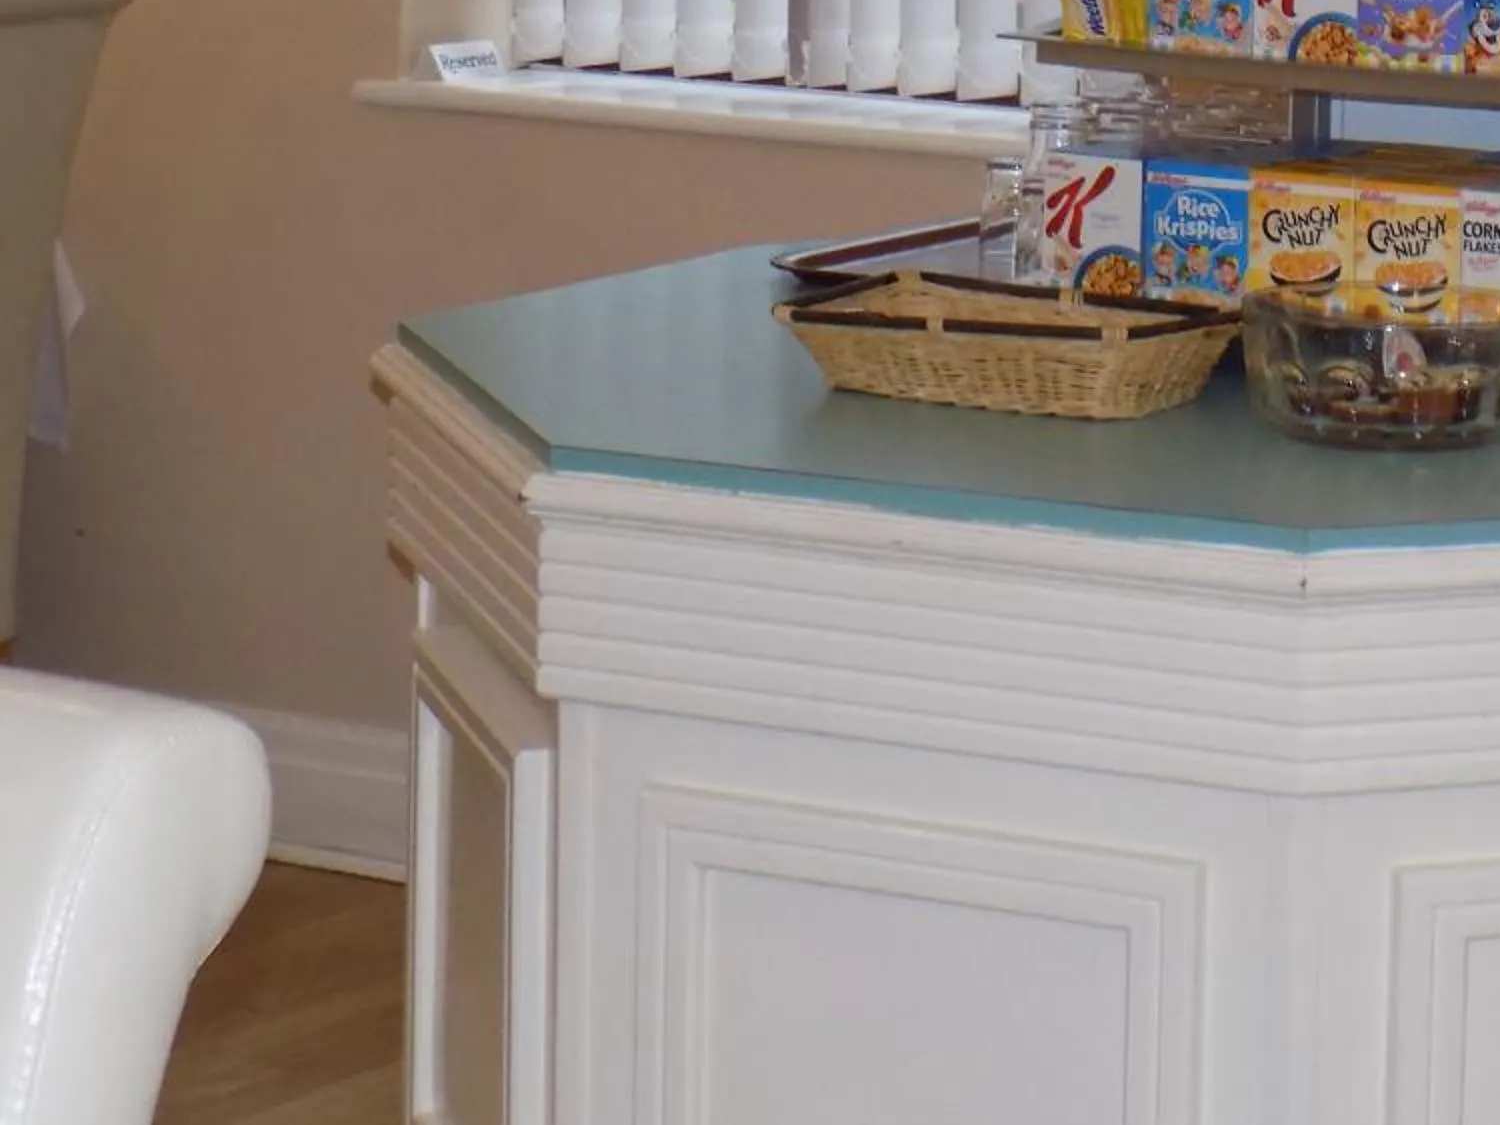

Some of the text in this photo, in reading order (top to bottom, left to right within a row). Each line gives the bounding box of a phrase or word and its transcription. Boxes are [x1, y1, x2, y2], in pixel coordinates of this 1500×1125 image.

[1045, 165, 1117, 250] K
[1176, 195, 1220, 218] Rice
[1154, 210, 1241, 242] Krispies
[1261, 202, 1342, 244] CRUNCHY
[1284, 227, 1326, 248] NUT
[1366, 211, 1449, 255] CRUNCHY
[1392, 237, 1432, 260] NUT
